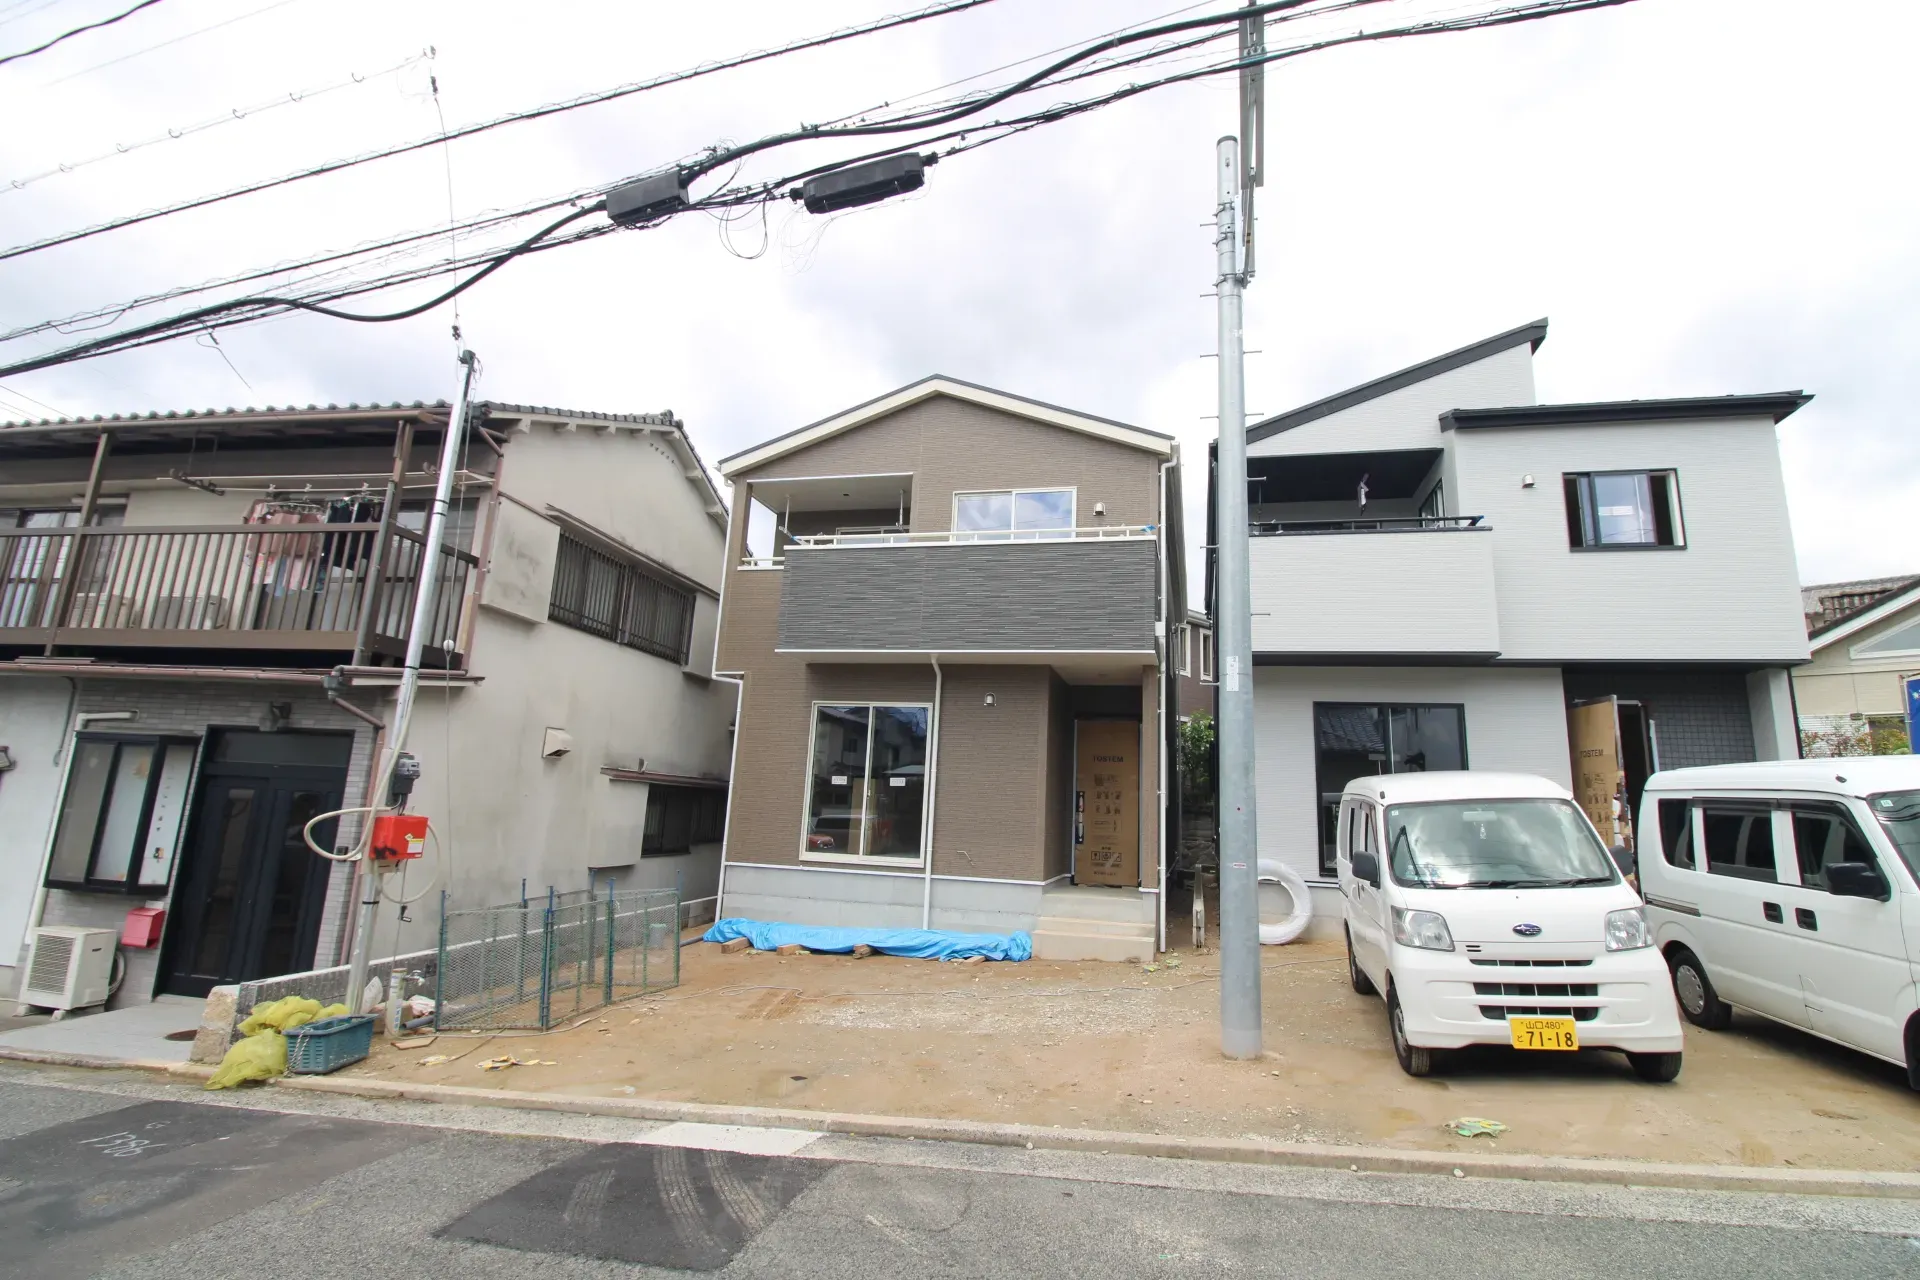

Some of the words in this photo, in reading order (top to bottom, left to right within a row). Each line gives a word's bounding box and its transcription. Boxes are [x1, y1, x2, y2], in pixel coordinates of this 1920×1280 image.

[1580, 749, 1603, 758] TOSTEM
[1092, 755, 1124, 763] TOSTEM
[1525, 1031, 1574, 1048] 71-18
